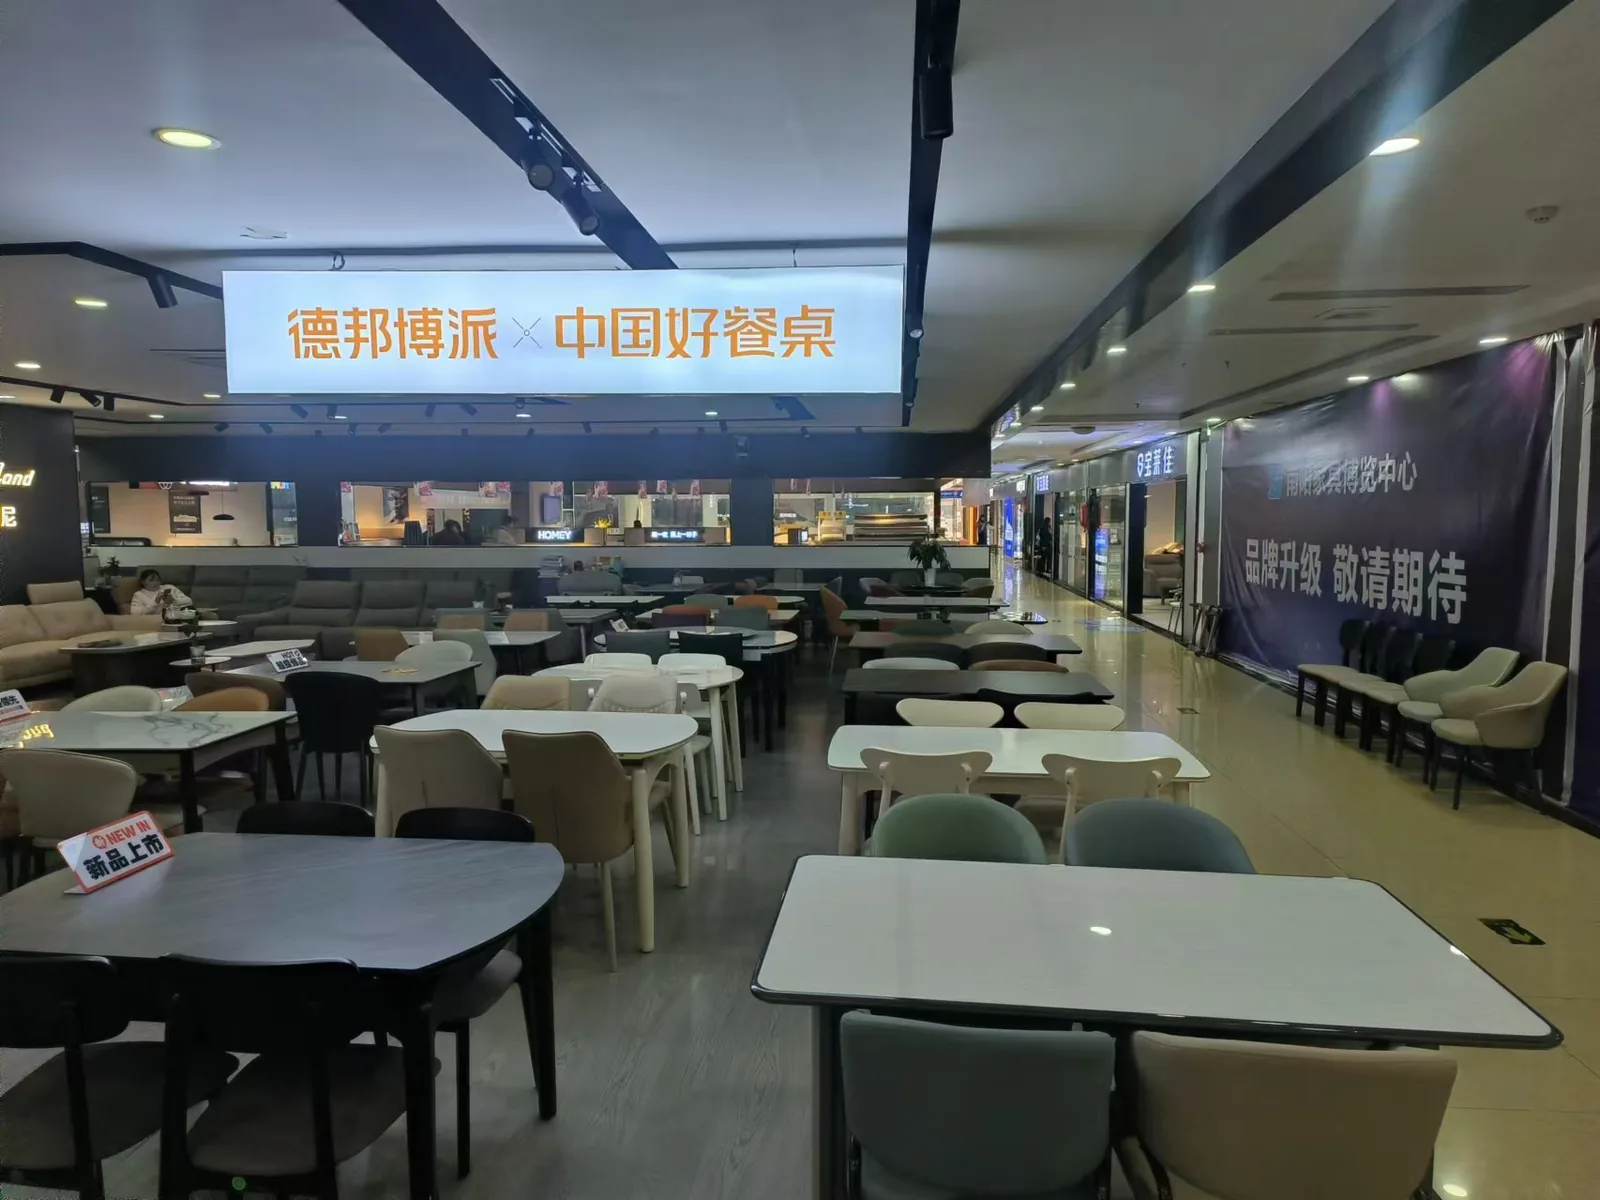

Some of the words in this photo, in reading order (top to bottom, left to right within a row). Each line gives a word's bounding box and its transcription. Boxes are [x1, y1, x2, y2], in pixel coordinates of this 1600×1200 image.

[287, 305, 499, 360] 德邦博派
[554, 303, 837, 360] 中国好餐桌
[537, 530, 573, 540] HOMEY
[1245, 538, 1322, 598] 品牌升级
[1332, 543, 1468, 625] 敬请期待
[106, 824, 136, 845] NEW
[137, 820, 151, 832] IN
[83, 834, 164, 880] 新品上市
